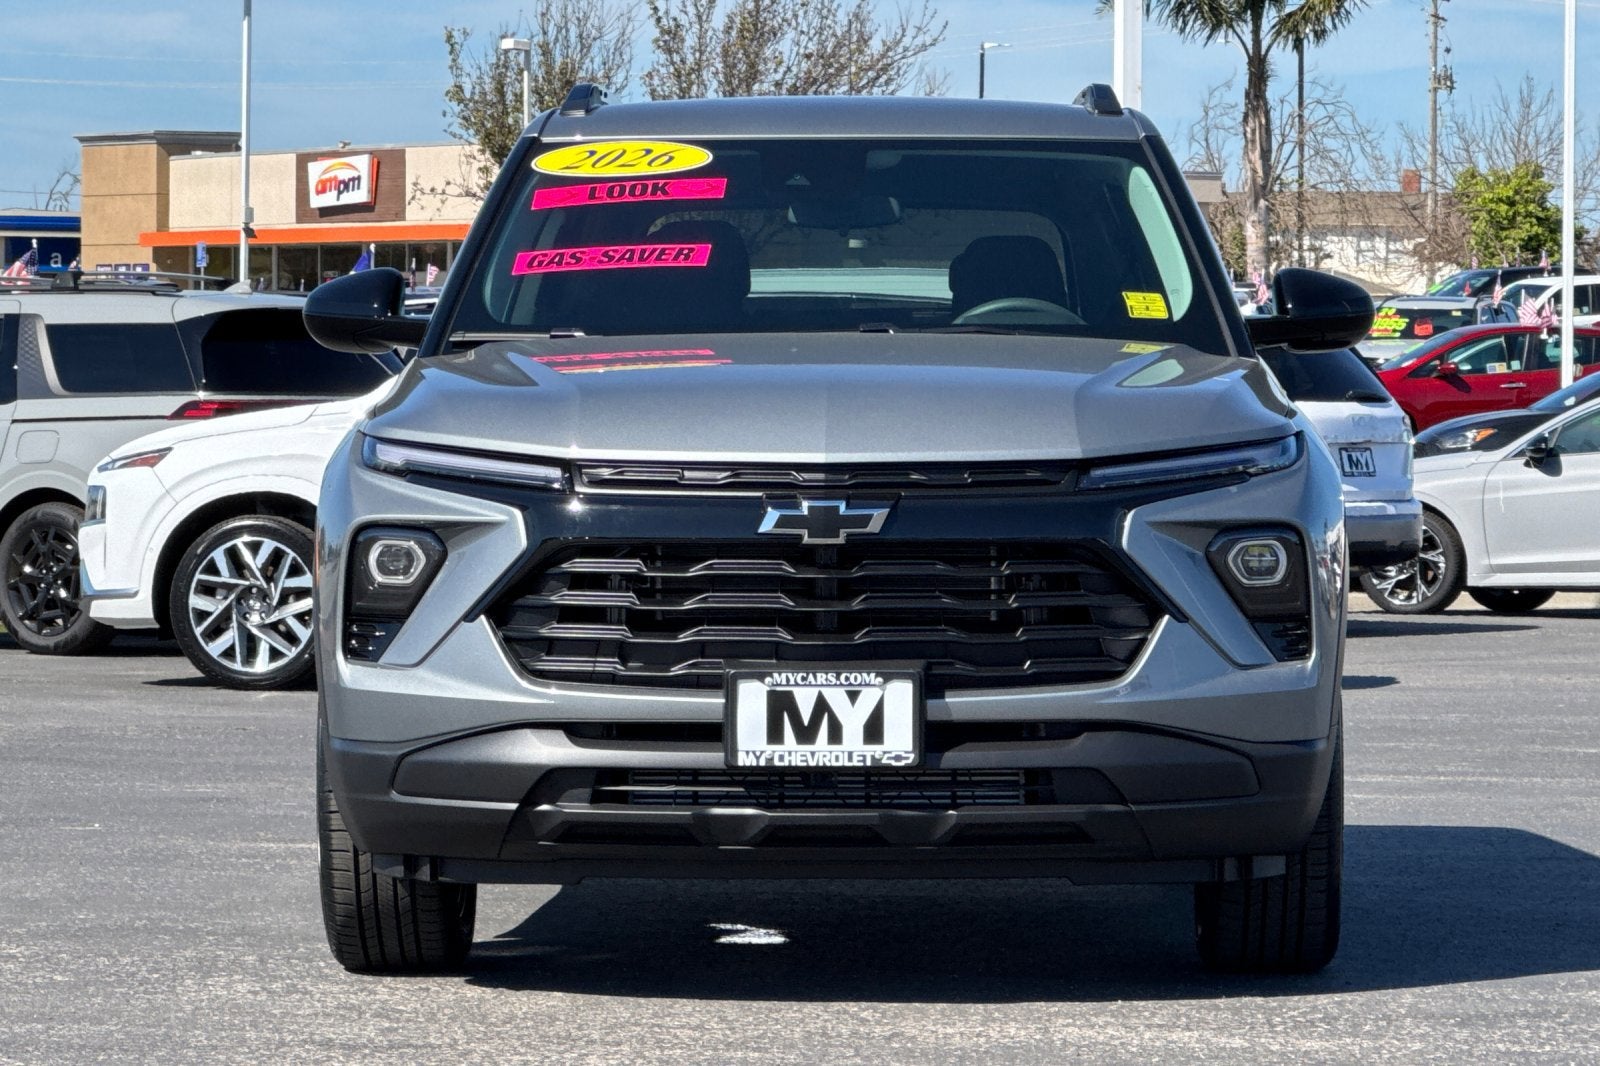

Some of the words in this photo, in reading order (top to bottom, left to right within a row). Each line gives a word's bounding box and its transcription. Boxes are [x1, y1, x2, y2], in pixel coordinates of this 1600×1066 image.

[558, 148, 684, 170] 2026
[314, 174, 362, 202] ampm
[587, 182, 673, 201] LOOK
[772, 672, 876, 686] MYCARS.COM
[766, 689, 885, 746] MY
[738, 751, 768, 766] MY
[773, 751, 873, 766] CHEVROLET
